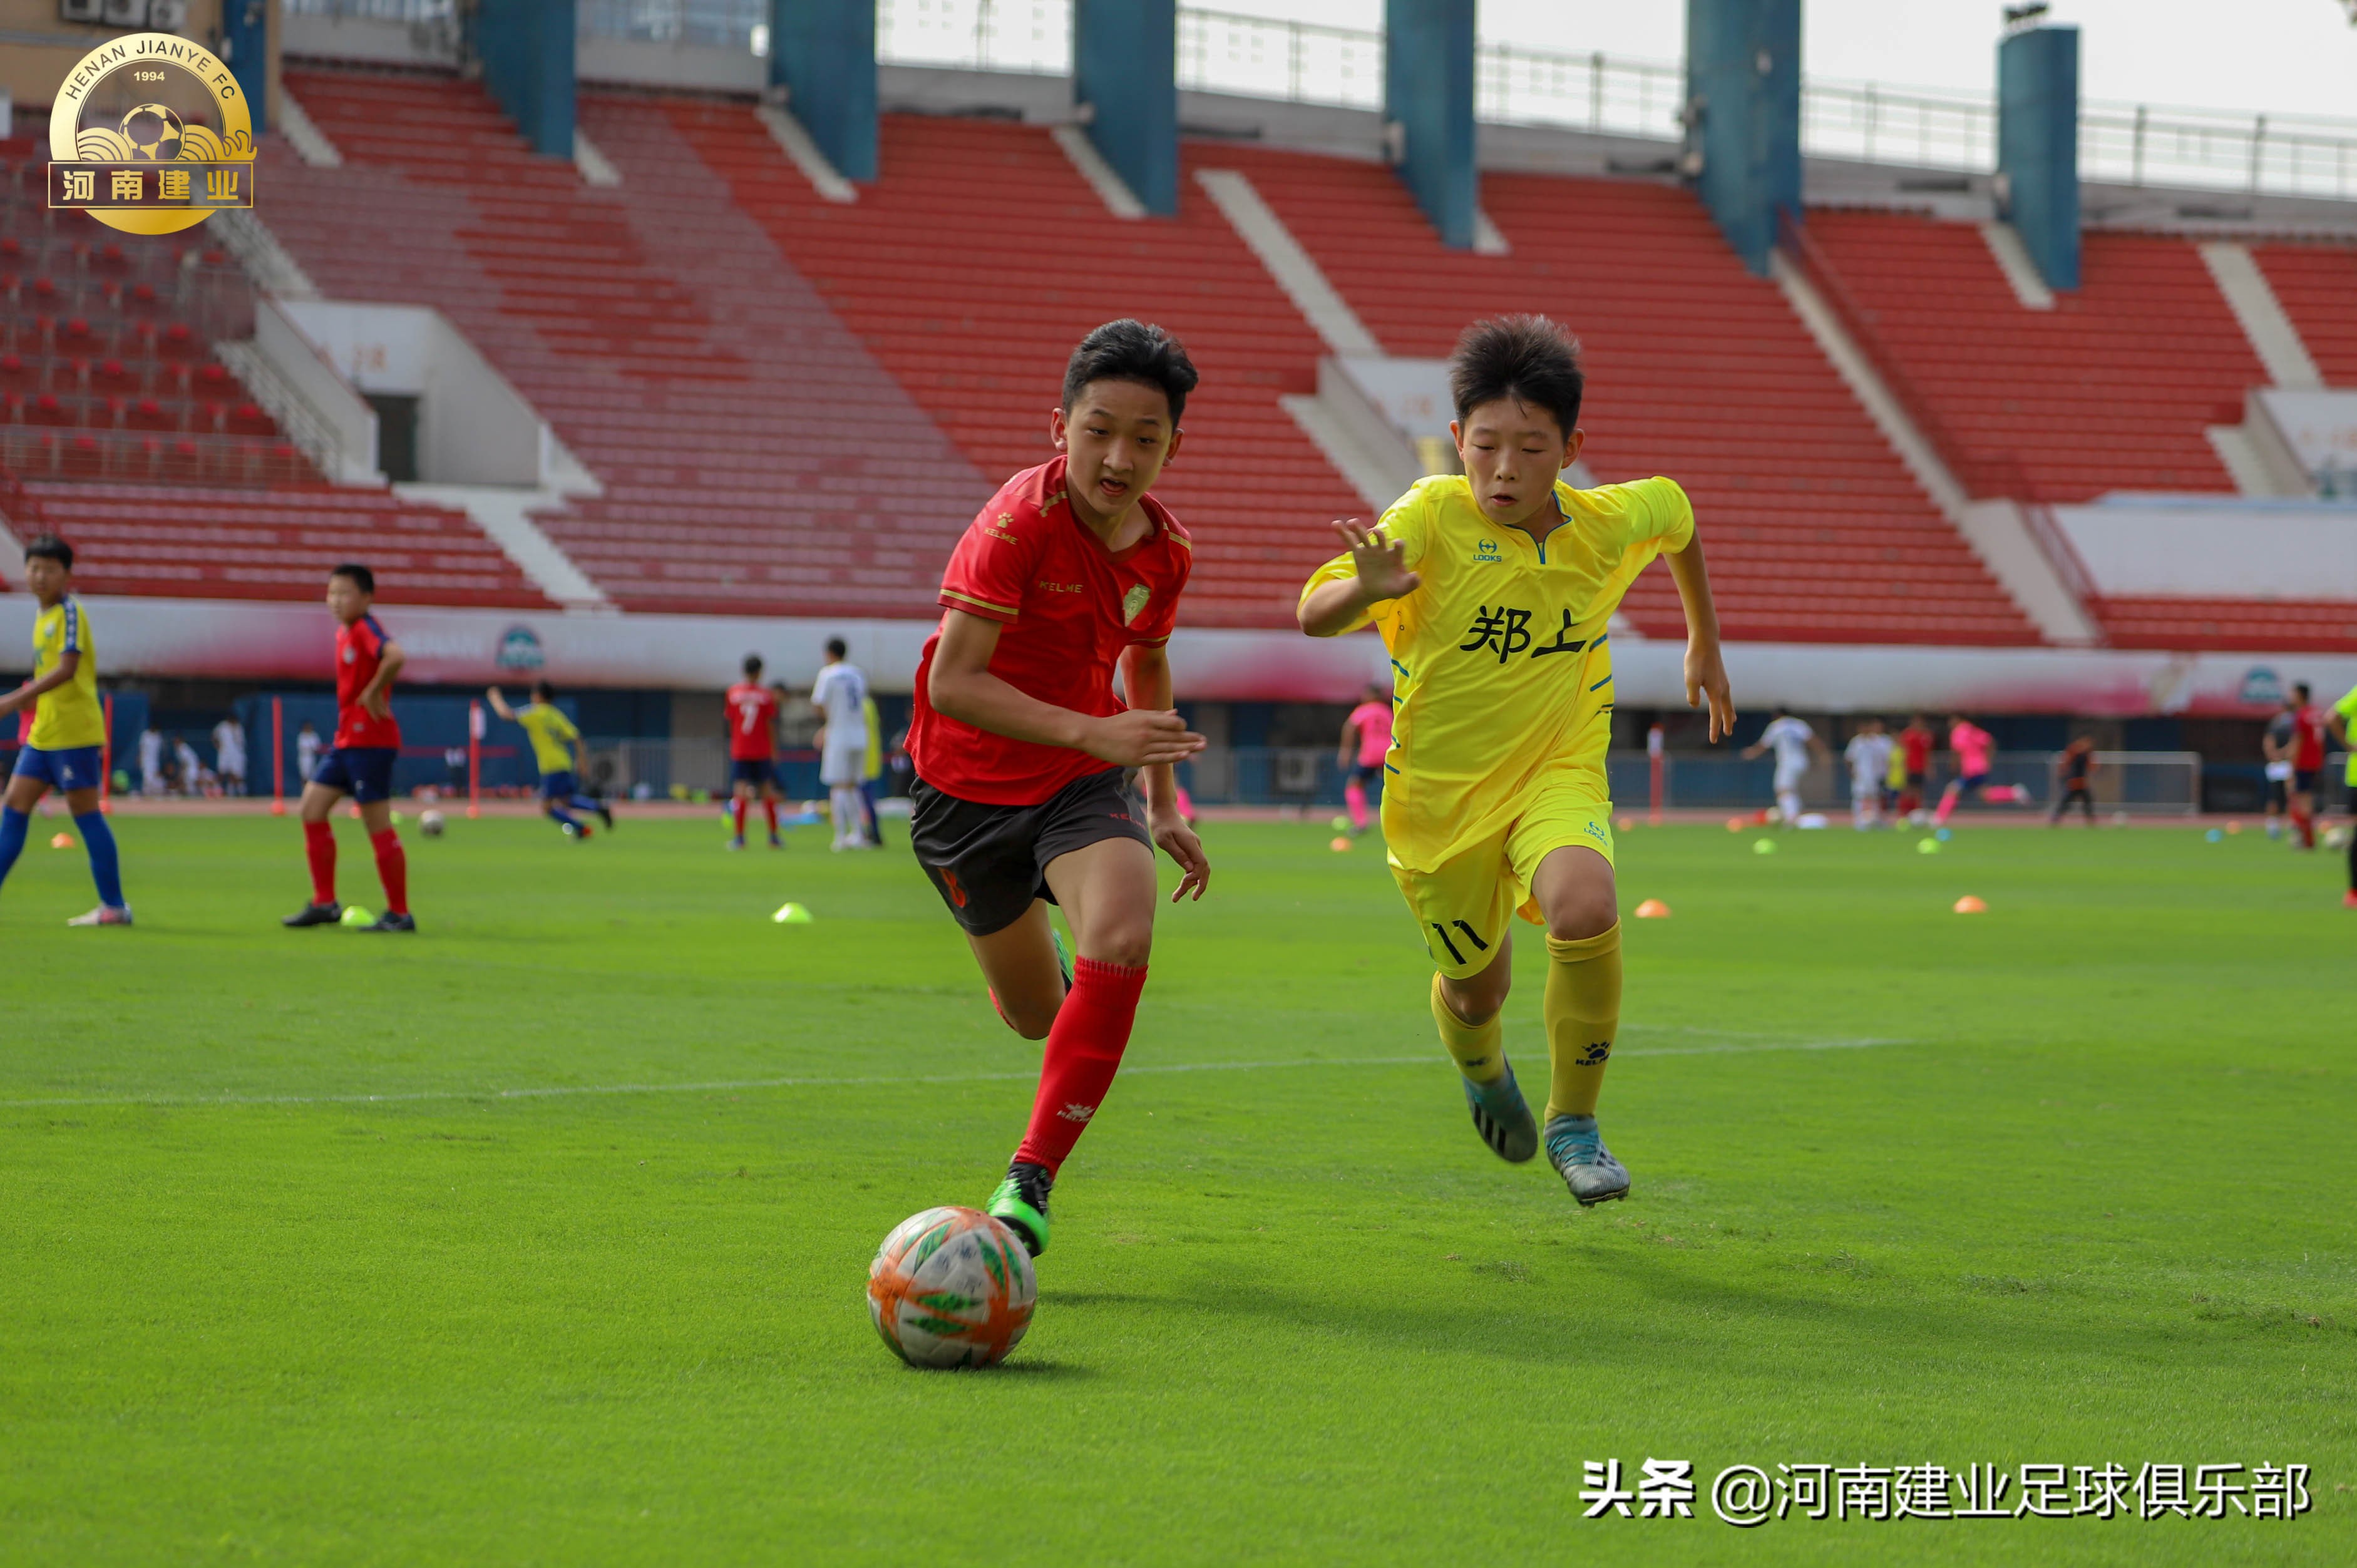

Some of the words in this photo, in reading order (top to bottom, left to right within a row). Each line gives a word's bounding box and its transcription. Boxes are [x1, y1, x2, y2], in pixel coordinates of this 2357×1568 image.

[1473, 553, 1503, 563] LOOKS
[1039, 580, 1084, 594] KELME
[1459, 605, 1588, 664] 郑上
[1430, 920, 1489, 965] 11
